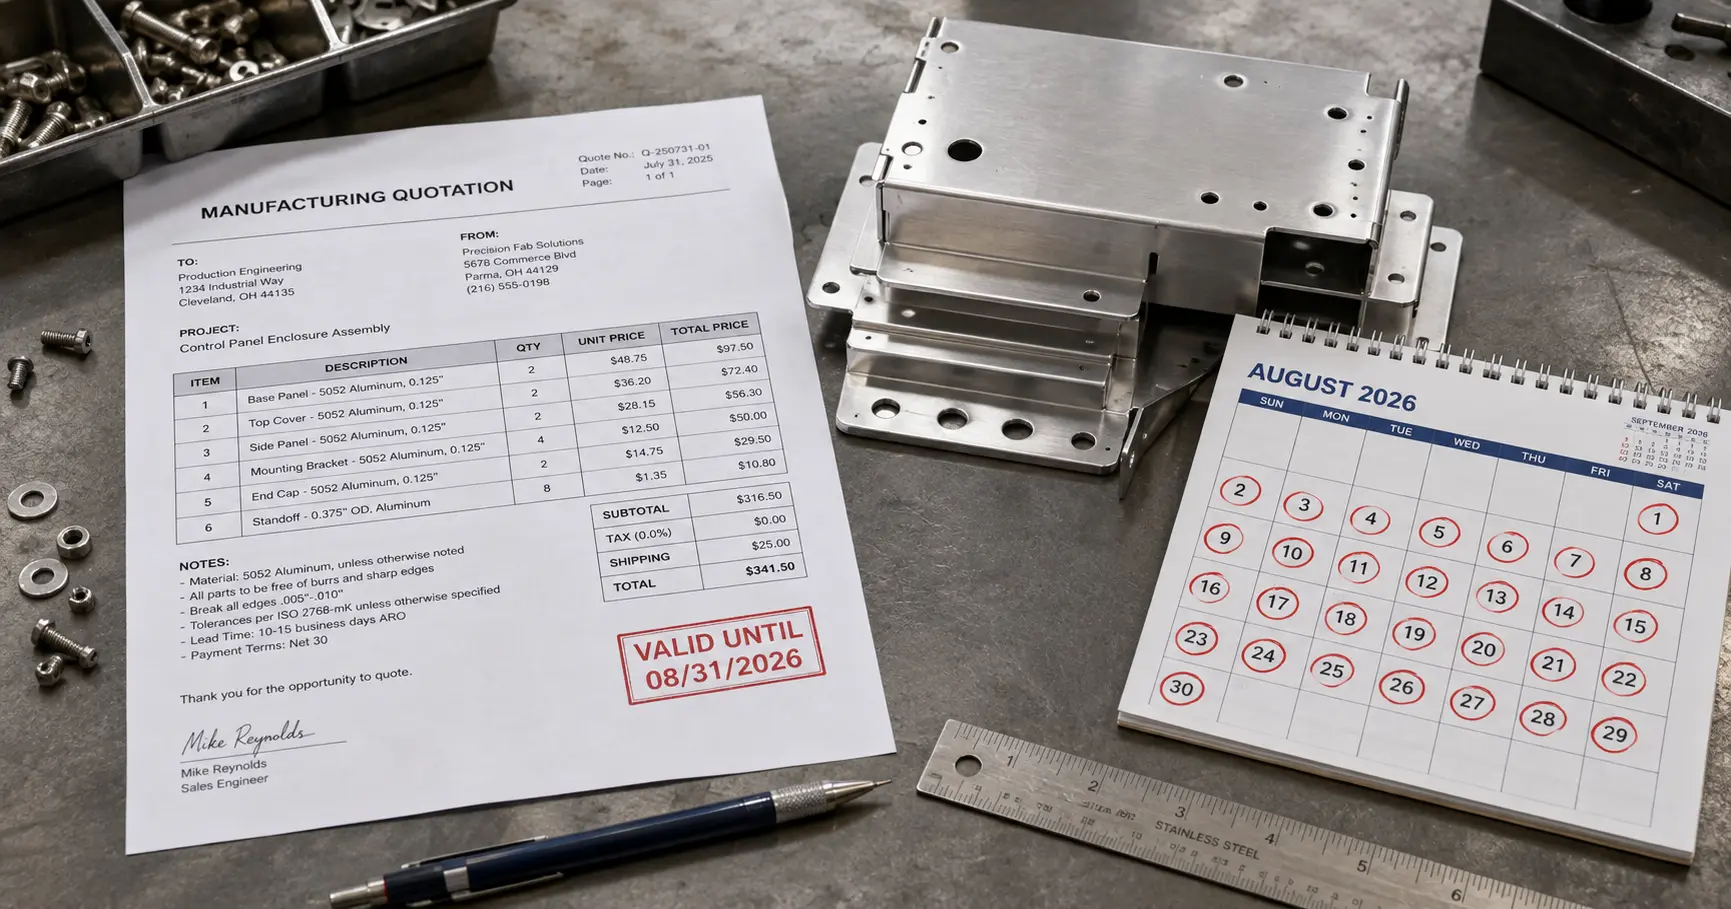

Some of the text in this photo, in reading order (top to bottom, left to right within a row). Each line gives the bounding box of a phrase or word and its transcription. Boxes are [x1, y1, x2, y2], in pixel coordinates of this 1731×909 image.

[641, 143, 710, 156] Q-250731-01
[578, 154, 611, 163] Quote
[643, 160, 664, 169] July
[687, 154, 714, 164] 2025
[580, 166, 608, 175] Date:
[201, 179, 514, 219] MANUFACTURING QUOTATION
[459, 230, 499, 241] FROM:
[462, 238, 584, 256] Precision Fab Solutions
[176, 257, 198, 267] TO:
[463, 250, 577, 269] 5678 Commerce Blvd
[178, 263, 302, 282] Production Engineering
[464, 264, 559, 281] Parma, OH 44129
[179, 277, 284, 294] 1234 Industrial Way
[466, 277, 550, 295] (216) 555-0198
[178, 287, 295, 307] Cleveland, OH 44135
[179, 324, 239, 338] PROJECT:
[669, 319, 750, 336] TOTAL PRICE
[179, 323, 391, 353] Control Panel Enclosure Assembly
[577, 330, 646, 346] UNIT PRICE
[515, 341, 541, 353] QTY
[716, 341, 754, 354] $97.50
[324, 356, 408, 373] DESCRIPTION
[610, 353, 647, 365] $48.75
[720, 364, 758, 376] $72.40
[190, 376, 221, 388] ITEM
[247, 394, 275, 404] Base
[277, 389, 308, 401] Panel
[318, 385, 346, 396] 5052
[408, 374, 444, 387] 0.125"
[613, 376, 651, 388] $36.20
[1247, 363, 1417, 412] AUGUST 2026
[724, 387, 762, 400] $56.30
[617, 398, 656, 412] $28.15
[729, 410, 767, 423] $50.00
[621, 422, 660, 435] $12.50
[1258, 396, 1682, 493] SUN MON TUE WED THU FRI SAT
[250, 463, 303, 476] Mounting
[306, 458, 348, 471] Bracket
[358, 453, 387, 464] 5052
[449, 442, 485, 454] 0.125"
[738, 457, 776, 470] $10.80
[635, 470, 667, 483] $1.35
[736, 490, 782, 504] $316.50
[252, 512, 300, 526] Standoff
[310, 507, 348, 520] 0.375"
[375, 499, 431, 512] Aluminum
[602, 504, 670, 520] SUBTOTAL
[753, 514, 786, 527] $0.00
[605, 527, 672, 543] TAX (0.0%)
[1234, 484, 1652, 581] 2 3 4 5 6 7 8
[751, 537, 791, 551] $25.00
[179, 557, 229, 572] NOTES:
[189, 572, 239, 586] Material:
[242, 568, 271, 580] 5052
[337, 558, 374, 569] unless
[376, 551, 430, 564] otherwise
[433, 545, 465, 557] noted
[609, 552, 670, 568] SHIPPING
[745, 561, 795, 576] $341.50
[612, 578, 656, 592] TOTAL
[1220, 532, 1647, 634] 9 10 11 12 13 14 15
[632, 620, 804, 661] VALID UNTIL
[1202, 580, 1637, 688] 16 17 18 19 20 21 22
[645, 647, 803, 690] 08/31/2026
[179, 668, 412, 704] Thank you for the opportunity to quote.
[1170, 680, 1194, 697] 30
[1184, 630, 1628, 743] 23 24 25 26 27 28 29
[181, 720, 315, 757] Mike Reynolds
[181, 759, 267, 778] Mike Reynolds
[181, 775, 269, 793] Sales Engineer
[1088, 780, 1099, 792] 2
[1175, 806, 1185, 818] 3
[1155, 820, 1219, 847] STAINLESS
[1223, 841, 1260, 860] STEEL
[1265, 834, 1275, 844] 4
[1357, 861, 1367, 873] 5
[1451, 888, 1462, 902] 6
